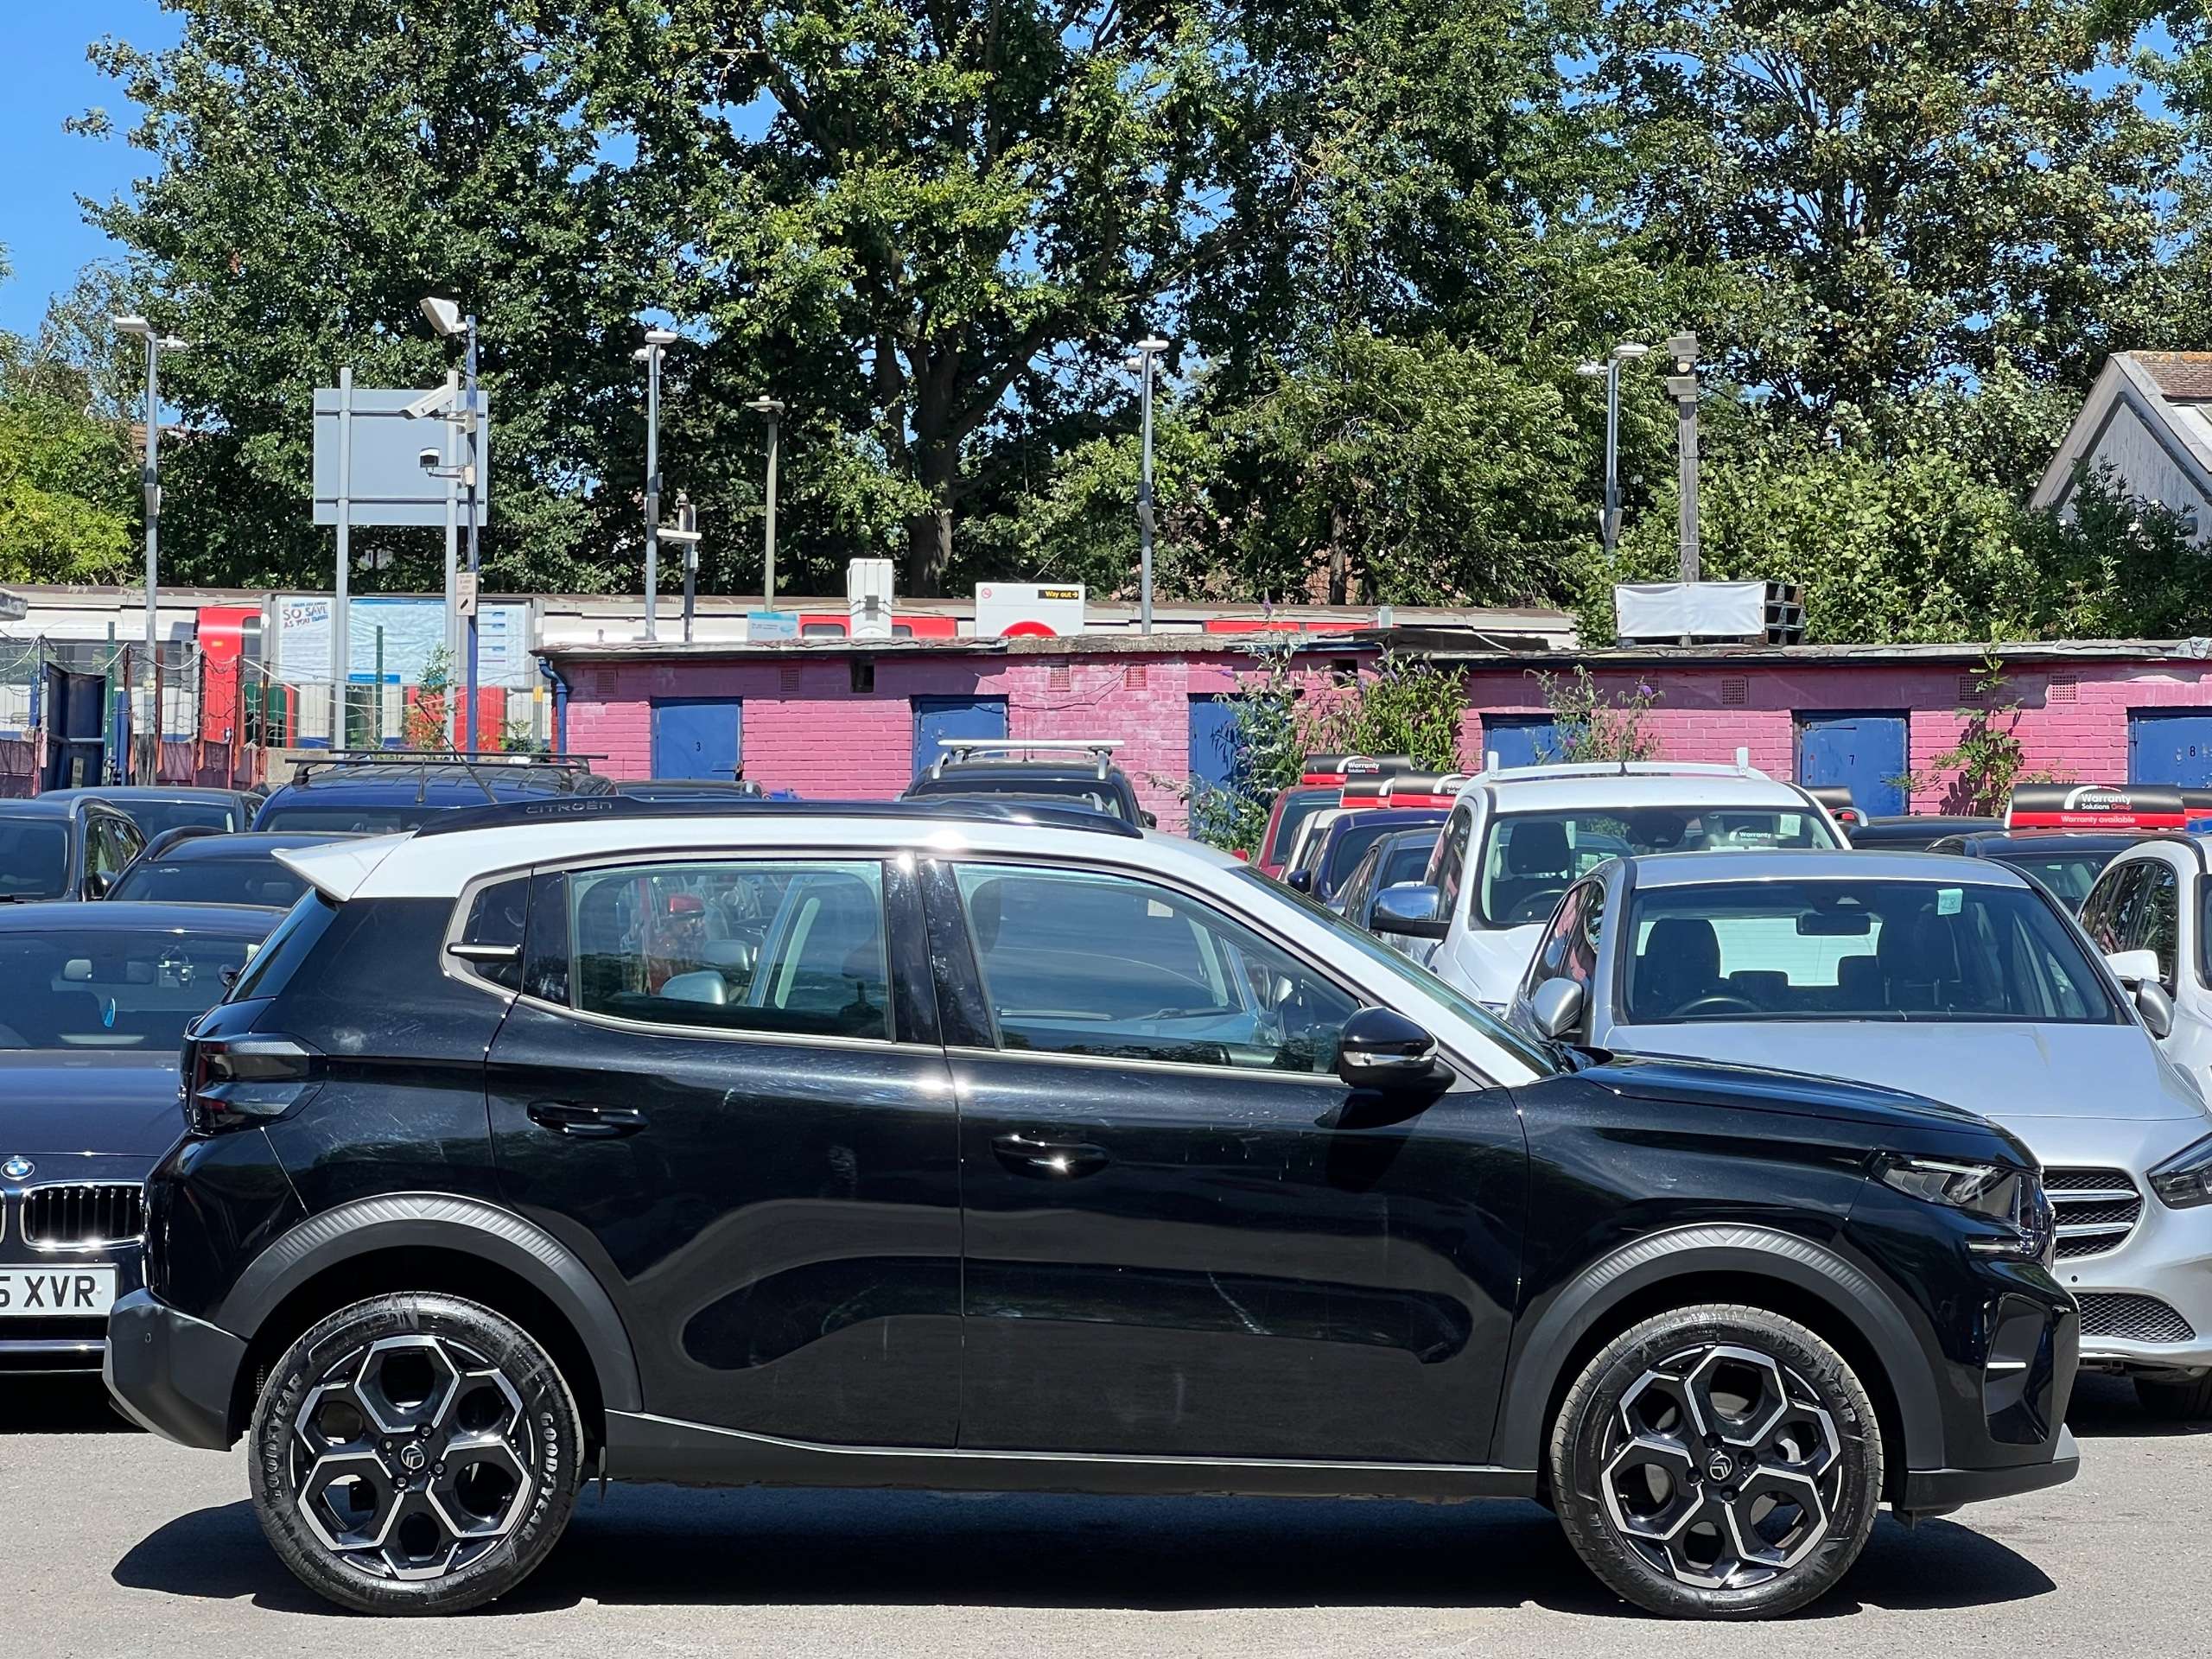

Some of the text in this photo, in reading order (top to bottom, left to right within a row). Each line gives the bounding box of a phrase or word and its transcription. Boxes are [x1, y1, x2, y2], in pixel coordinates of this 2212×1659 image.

[283, 608, 302, 621] SO
[696, 741, 701, 752] 3
[2190, 746, 2196, 757] 8
[1849, 754, 1855, 766] 7
[1348, 761, 1380, 771] Warranty
[2081, 794, 2131, 805] Warranty
[525, 800, 613, 814] CITROËN
[2111, 803, 2133, 811] Group
[2061, 815, 2136, 825] Warranty available
[23, 1275, 96, 1307] XVR
[520, 1411, 559, 1542] GOODYEAR
